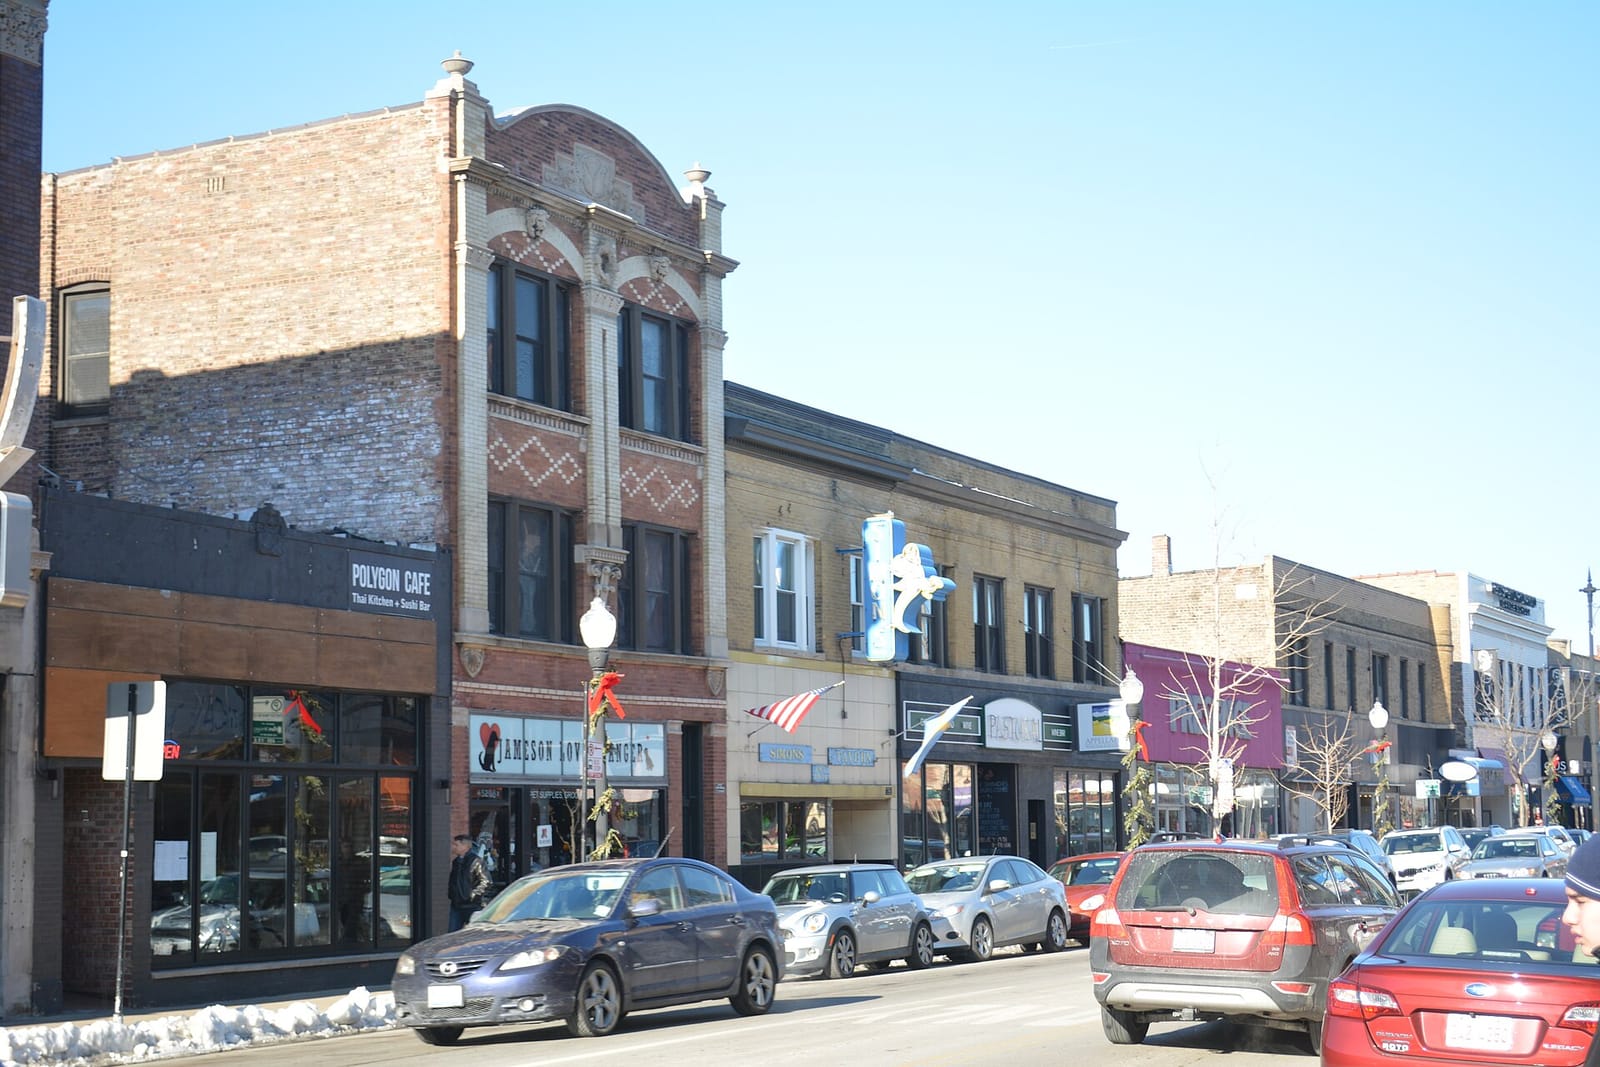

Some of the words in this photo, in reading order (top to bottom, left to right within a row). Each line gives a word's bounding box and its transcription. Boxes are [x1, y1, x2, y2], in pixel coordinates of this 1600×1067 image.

[352, 563, 400, 592] POLYGON
[404, 570, 431, 596] CAFE
[352, 592, 367, 604] Thai
[368, 594, 394, 607] Kitchen
[400, 598, 418, 610] Sushi
[419, 600, 431, 611] Bar
[497, 738, 552, 763] JAMESON
[559, 741, 580, 761] LOV
[608, 743, 643, 763] ANGER
